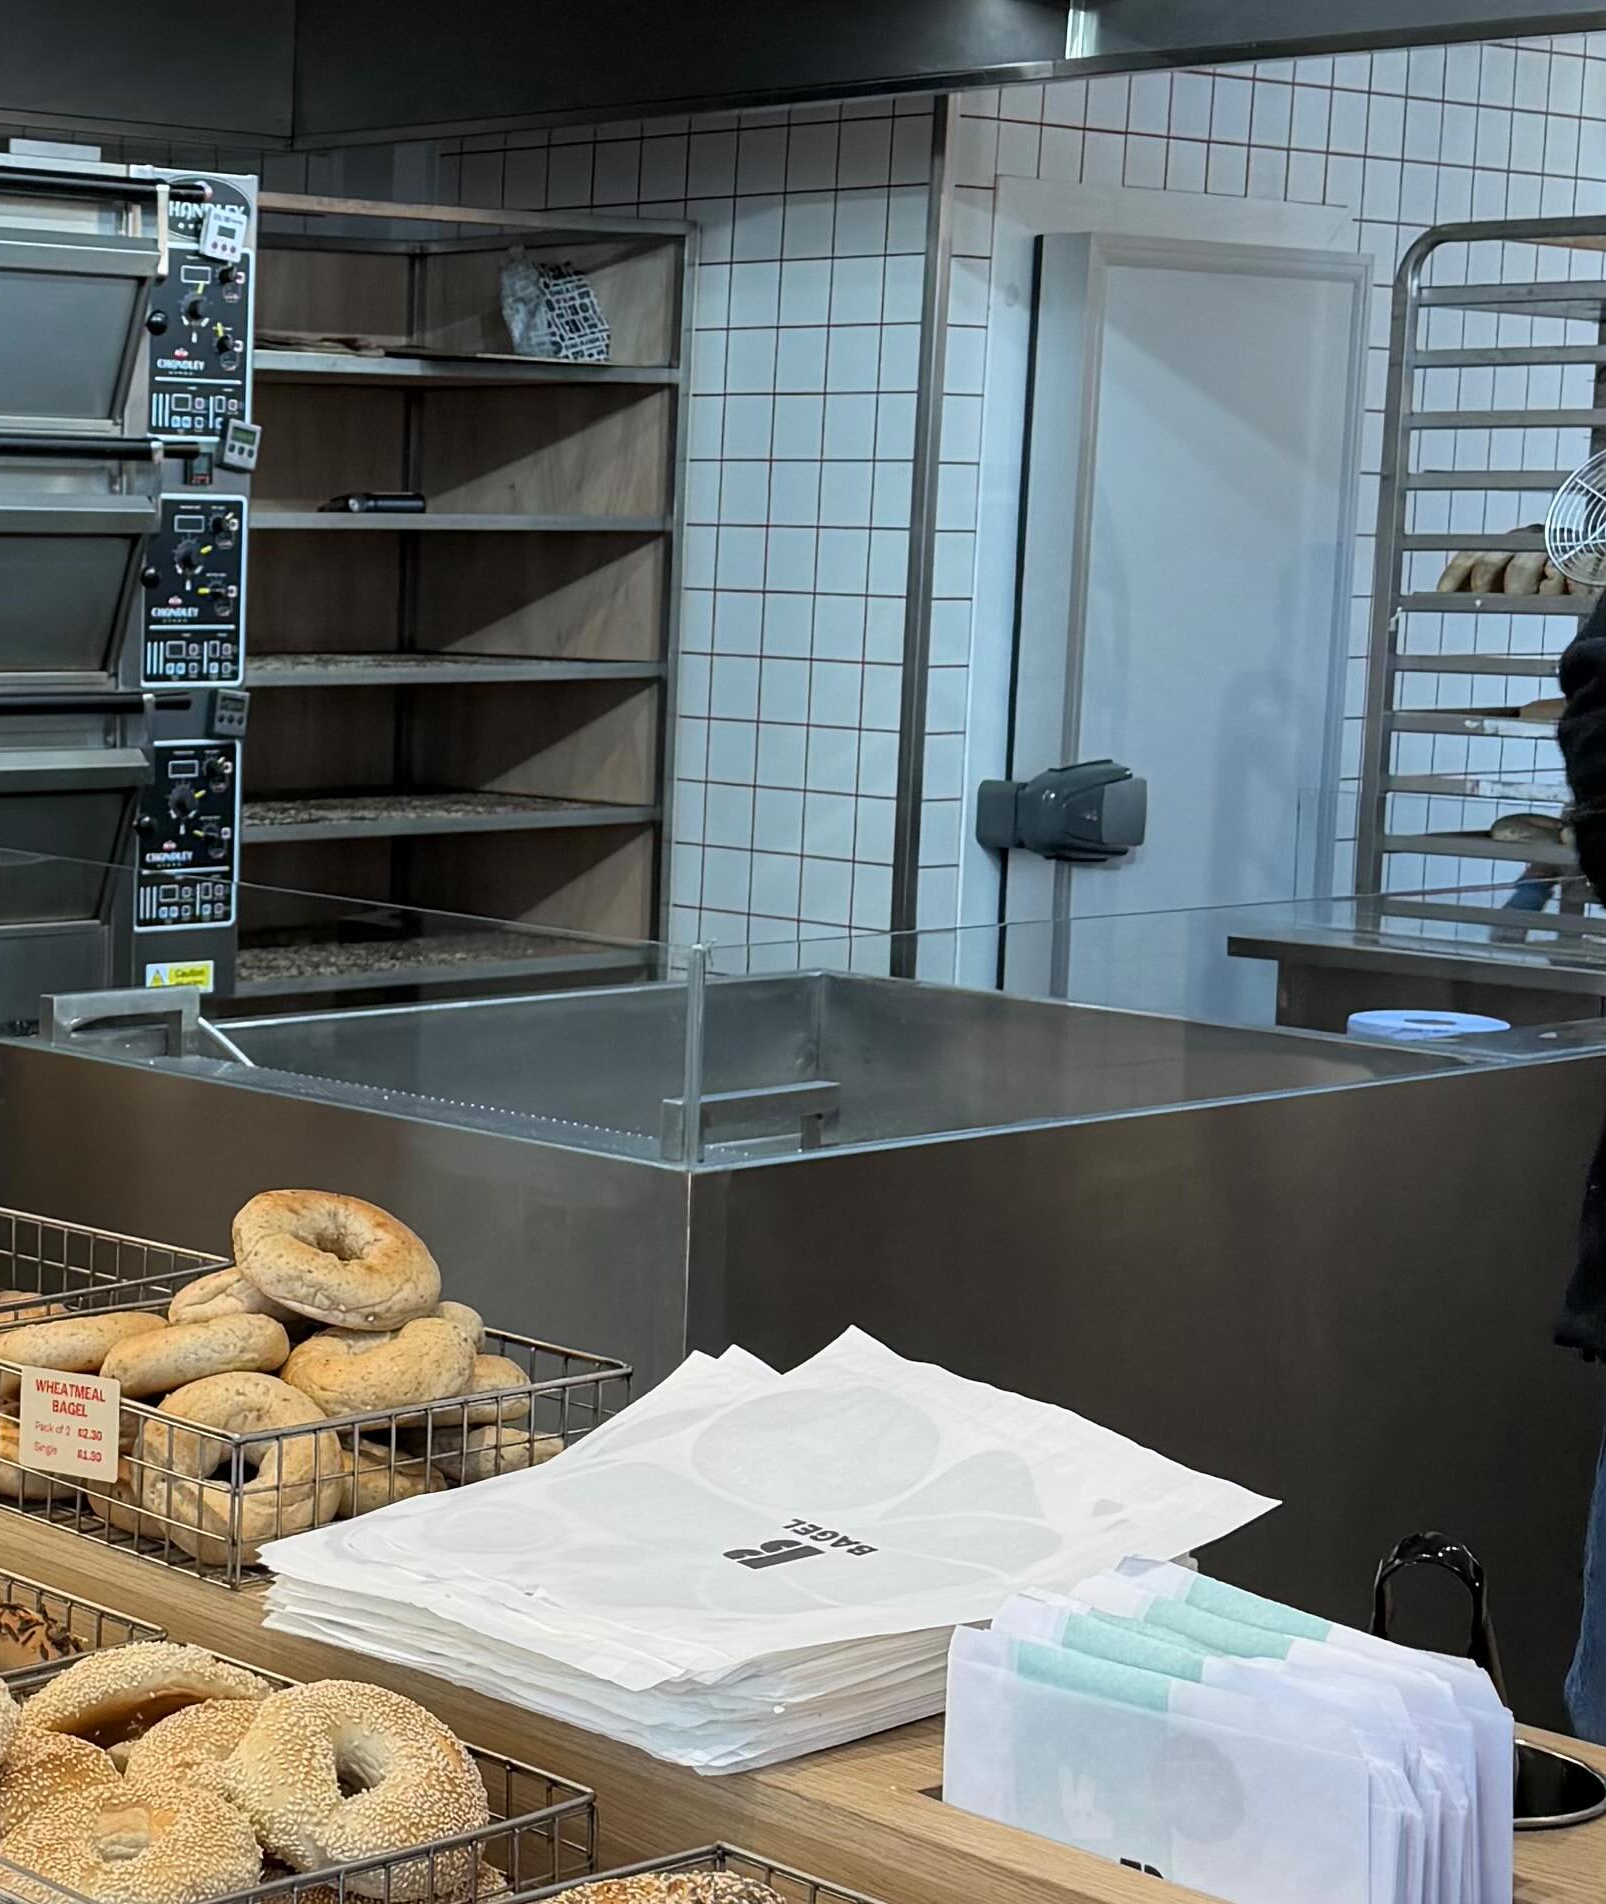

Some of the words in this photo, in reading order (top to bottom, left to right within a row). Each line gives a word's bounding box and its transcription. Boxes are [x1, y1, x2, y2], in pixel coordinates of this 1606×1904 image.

[35, 1379, 106, 1402] WHEATMEAL
[52, 1399, 88, 1417] BAGEL
[782, 1517, 879, 1558] BAGEL
